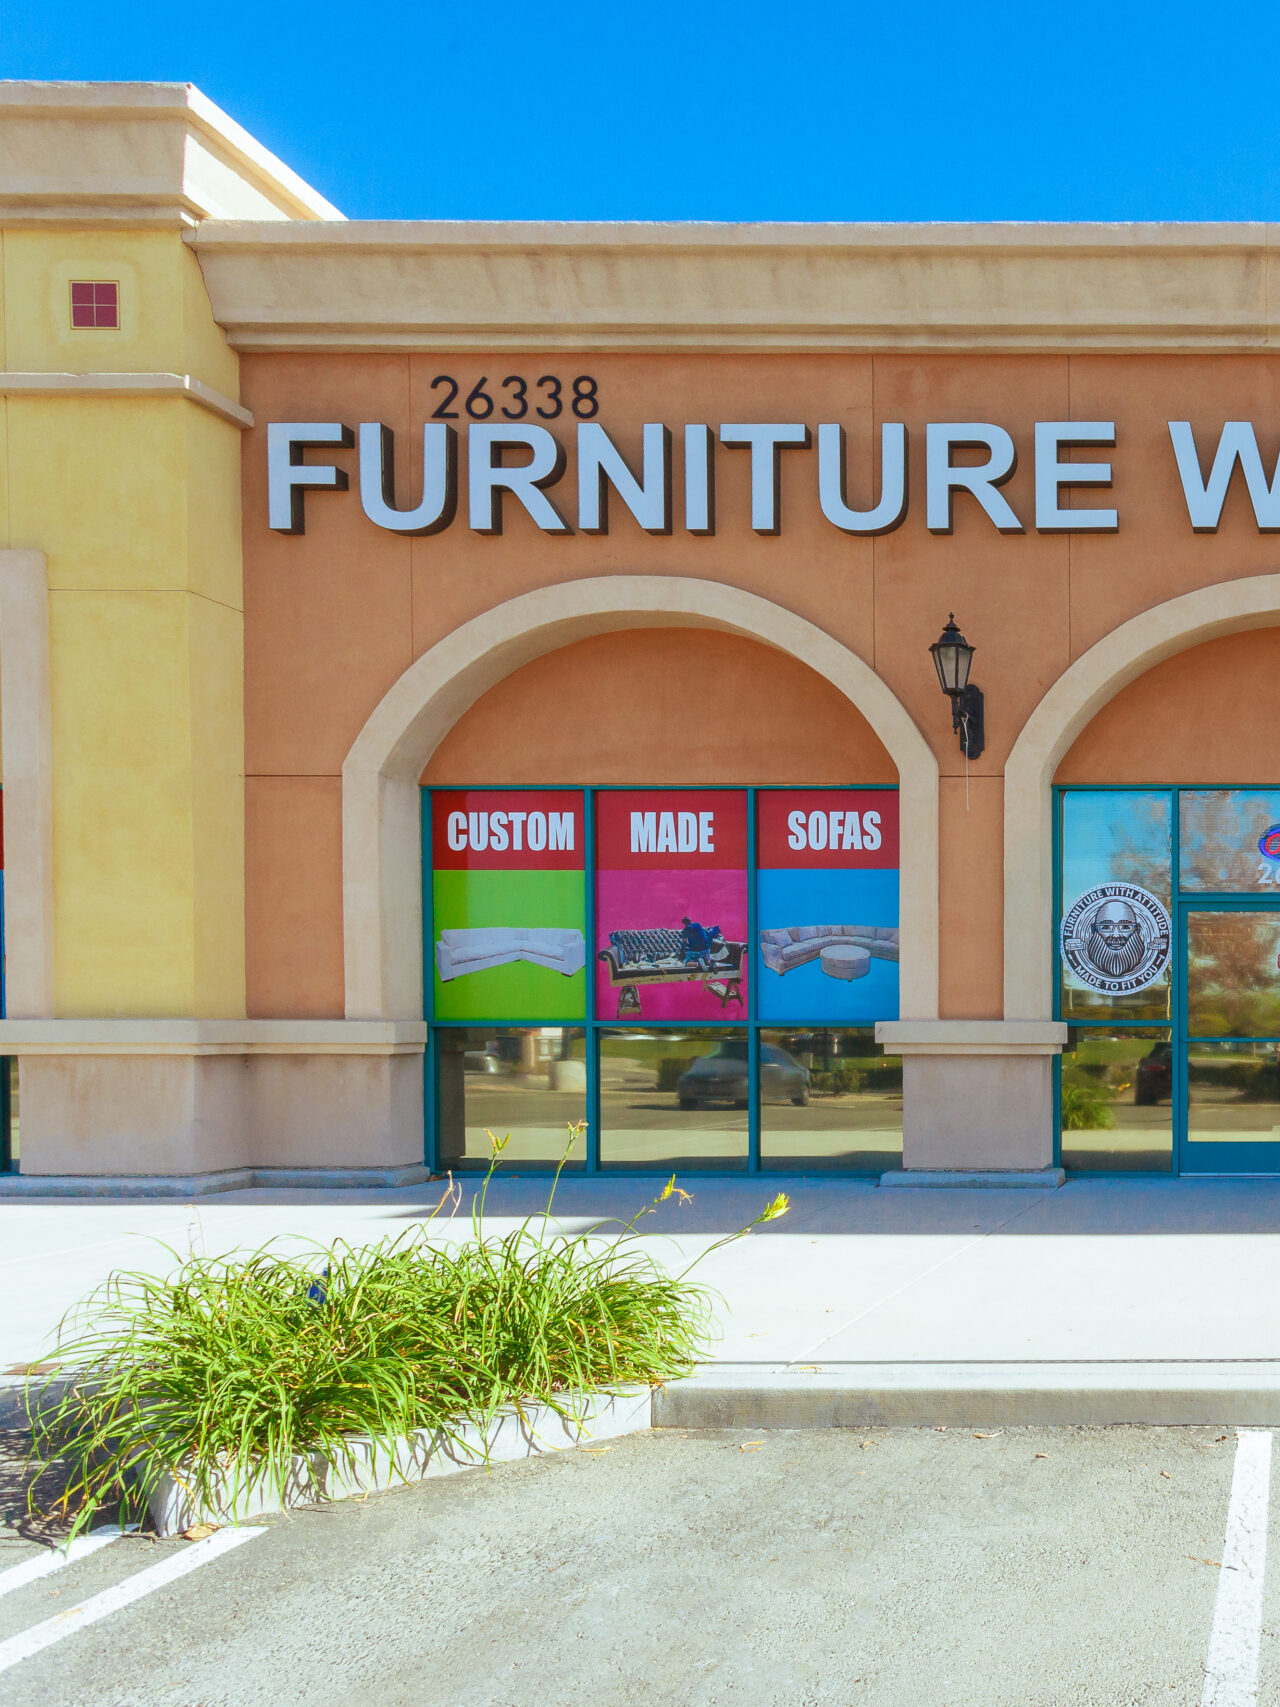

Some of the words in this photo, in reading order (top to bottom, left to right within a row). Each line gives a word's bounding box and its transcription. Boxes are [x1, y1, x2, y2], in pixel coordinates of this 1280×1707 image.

[431, 375, 600, 420] 26338
[266, 421, 1120, 536] FURNITURE
[446, 811, 575, 852] CUSTOM
[630, 811, 714, 853] MADE
[787, 810, 882, 851] SOFAS
[1064, 890, 1104, 936] FURNITURE
[1105, 887, 1134, 898] WITH
[1135, 892, 1169, 936] ATTITUDE
[1074, 964, 1102, 988] MADE
[1104, 981, 1119, 990] TO
[1121, 980, 1137, 990] FIT
[1138, 964, 1158, 983] YOU
